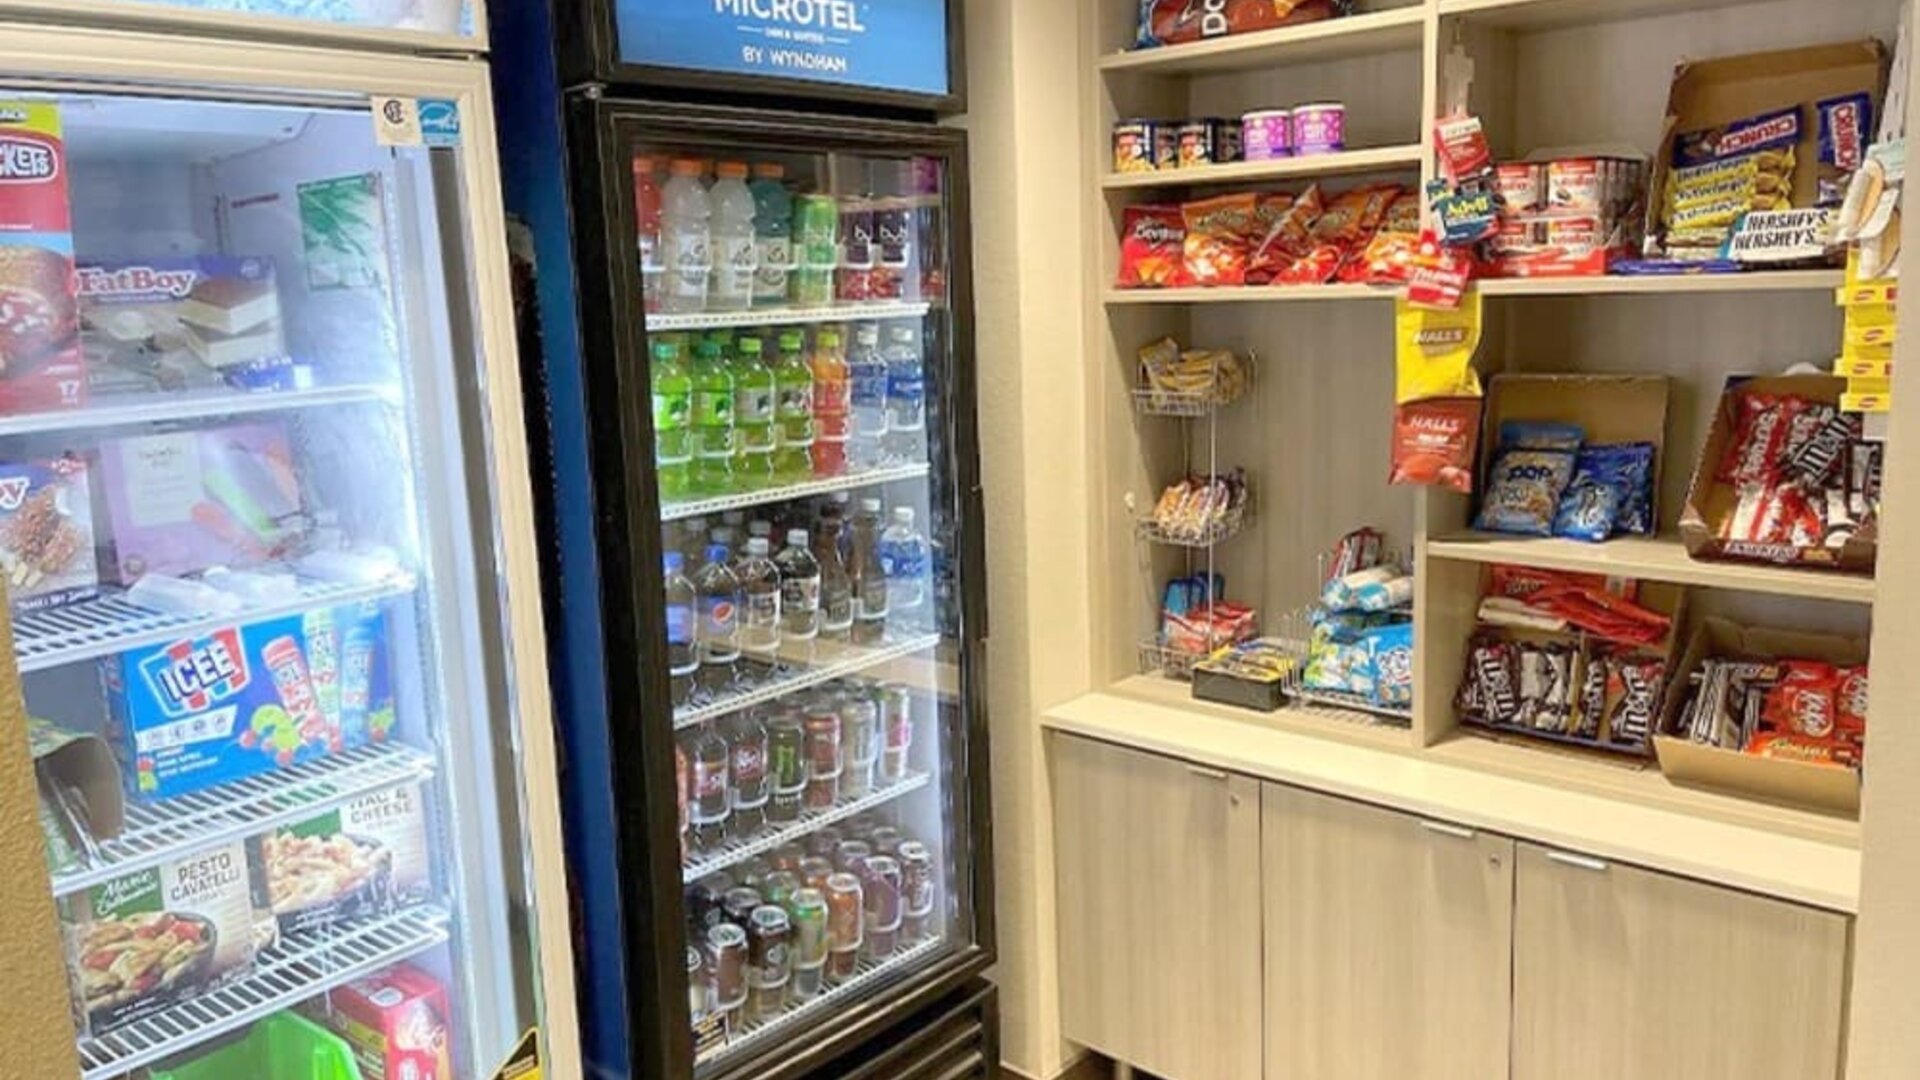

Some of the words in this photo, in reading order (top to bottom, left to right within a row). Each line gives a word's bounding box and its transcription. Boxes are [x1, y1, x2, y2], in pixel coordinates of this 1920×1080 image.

[743, 45, 763, 64] BY
[770, 49, 847, 71] WYNDHAM
[80, 267, 196, 297] FatBoy
[1415, 329, 1463, 343] HALLS
[1411, 416, 1459, 430] HALLS
[158, 643, 236, 702] ICEE
[178, 853, 231, 882] PESTO
[170, 867, 240, 901] CAVATELLI
